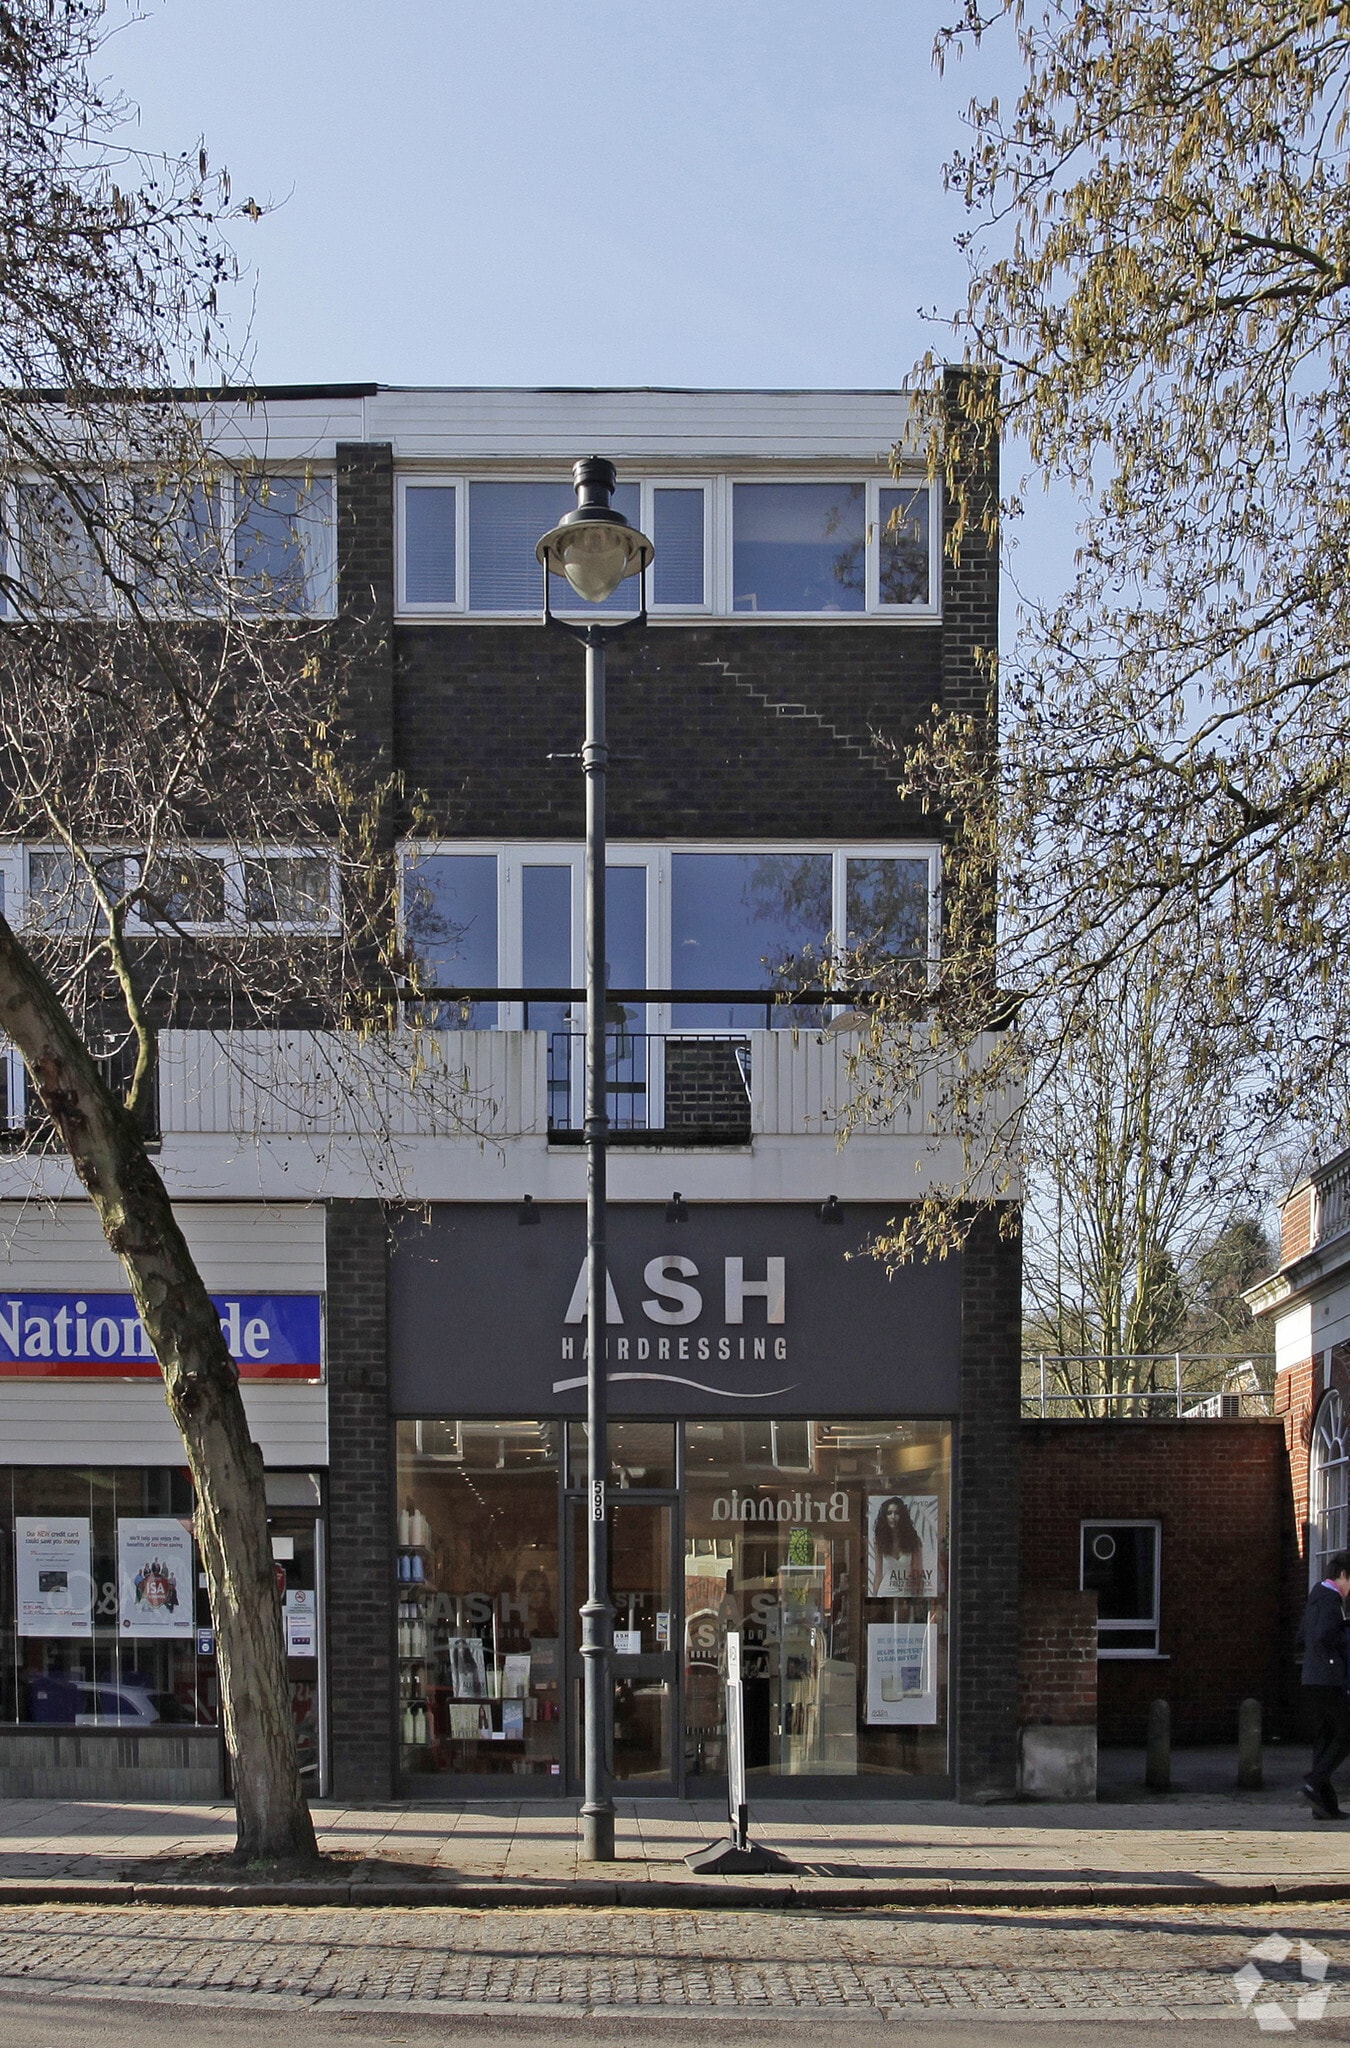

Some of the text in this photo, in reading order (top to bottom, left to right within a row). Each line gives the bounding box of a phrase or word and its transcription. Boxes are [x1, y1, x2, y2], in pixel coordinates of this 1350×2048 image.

[564, 1255, 786, 1326] ASH
[0, 1301, 270, 1358] Nationde
[594, 1481, 603, 1520] 599
[146, 1582, 165, 1594] ISA
[432, 1592, 529, 1623] ASH
